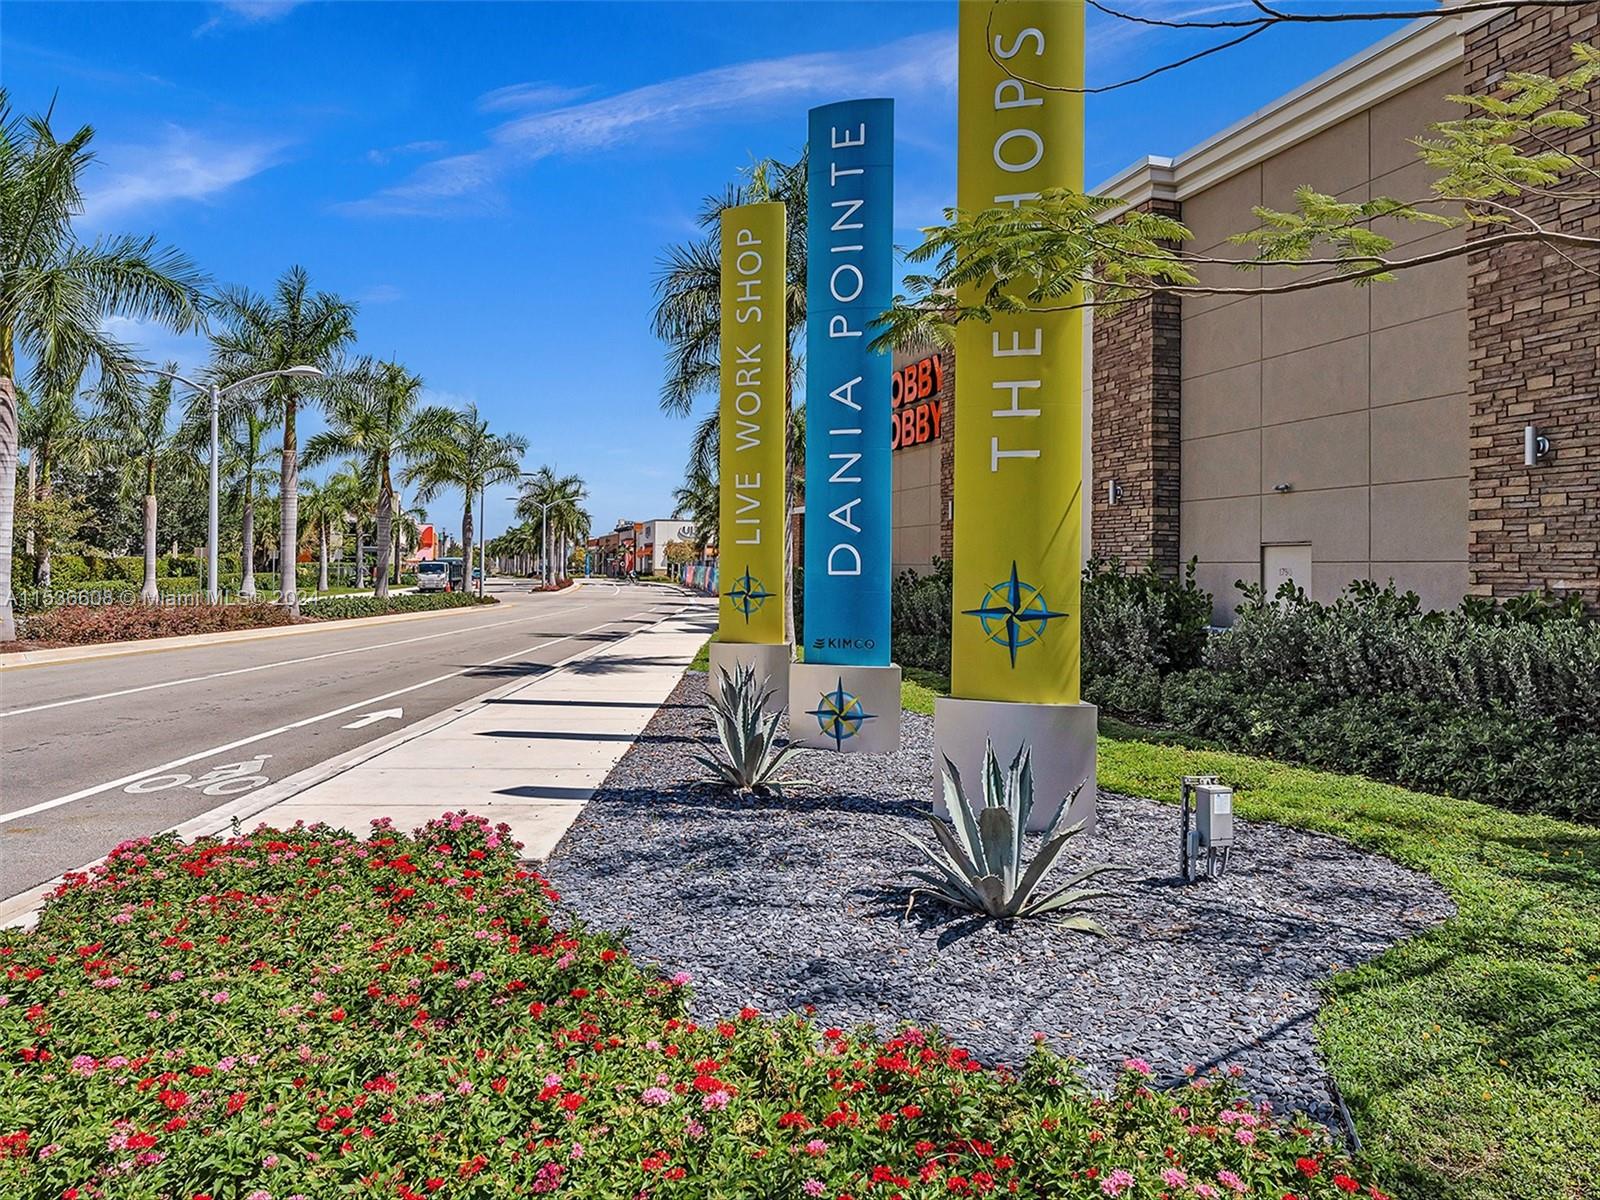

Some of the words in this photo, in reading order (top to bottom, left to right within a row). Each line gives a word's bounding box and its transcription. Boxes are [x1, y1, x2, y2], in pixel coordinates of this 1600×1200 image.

[735, 228, 763, 324] SHOP
[829, 122, 865, 338] POINTE
[735, 343, 762, 452] WORK
[892, 354, 943, 408] OBBY
[892, 400, 943, 450] OBBY
[990, 328, 1042, 473] THE
[735, 472, 761, 545] LIVE
[828, 376, 863, 577] DANIA
[827, 639, 875, 650] KIMCO
